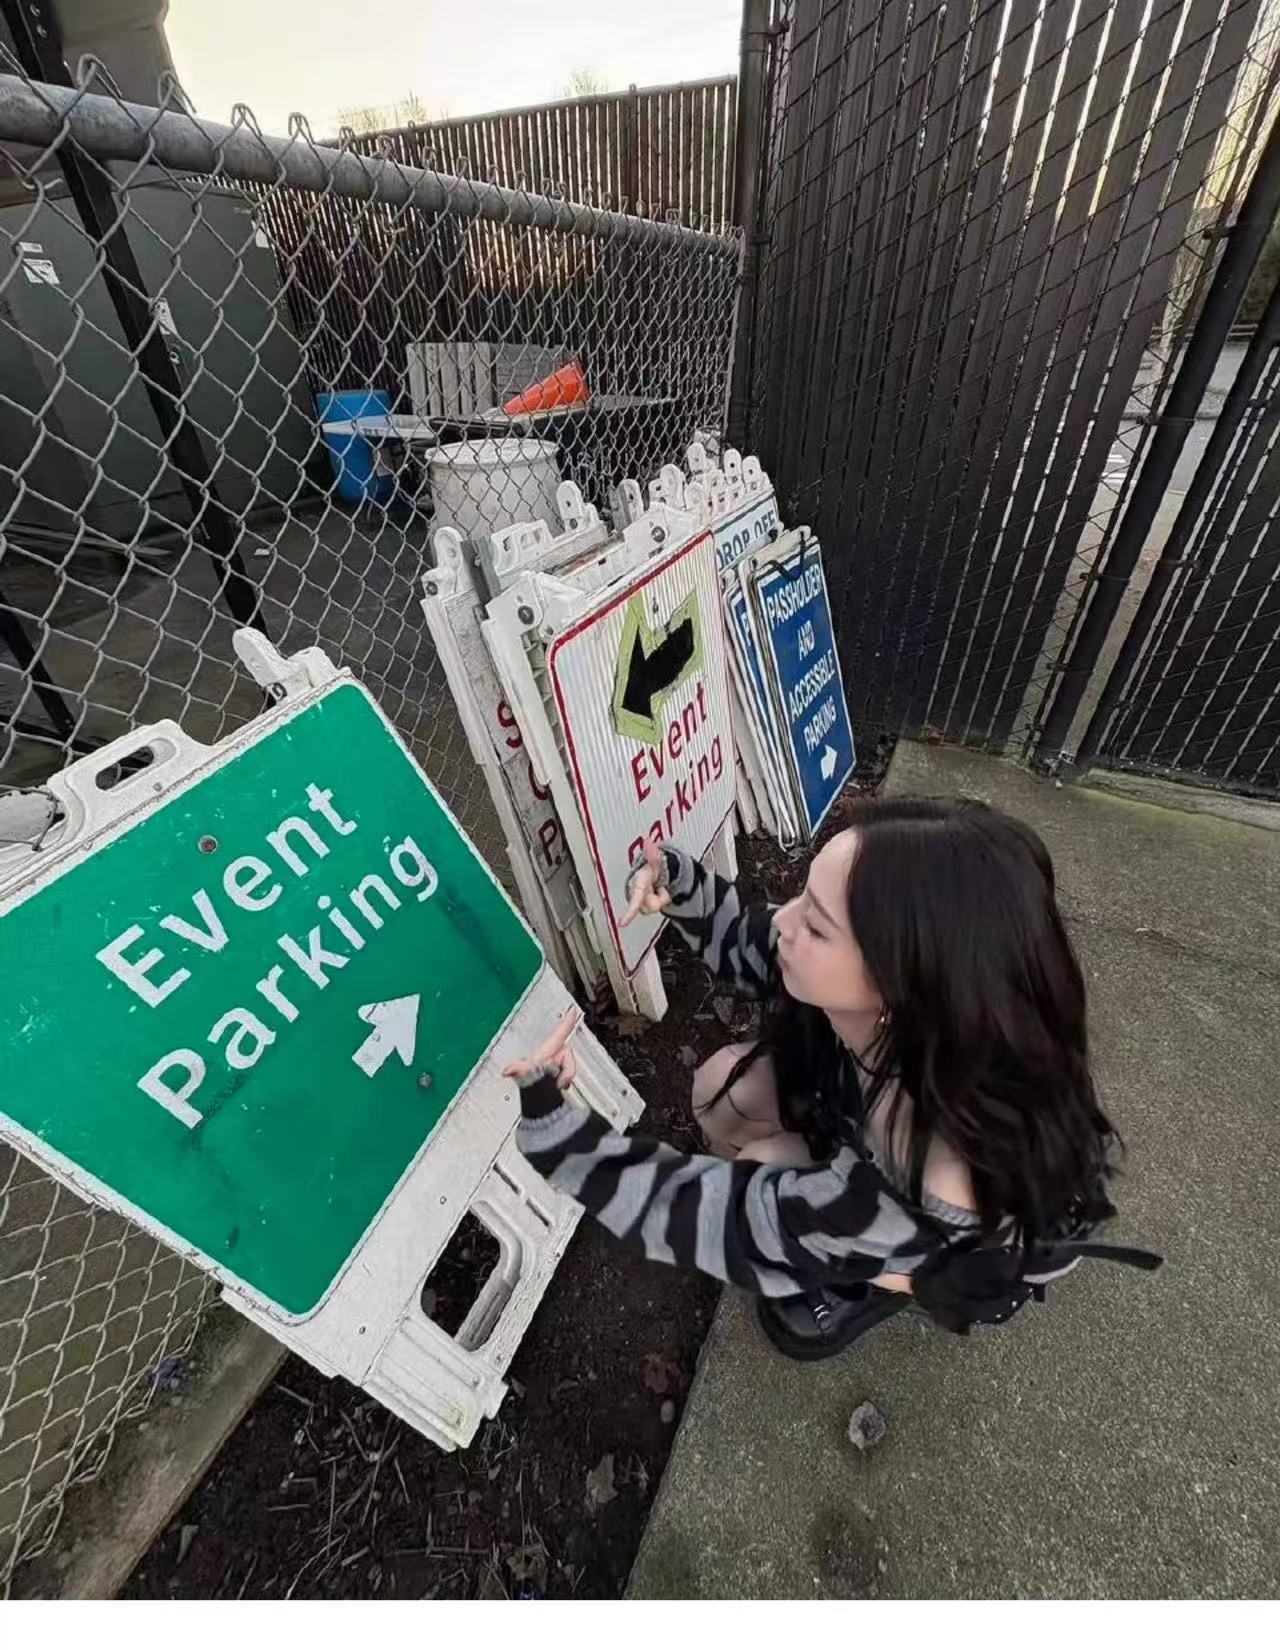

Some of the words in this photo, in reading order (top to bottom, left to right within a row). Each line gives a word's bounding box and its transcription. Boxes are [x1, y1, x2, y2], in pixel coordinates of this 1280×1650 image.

[766, 563, 823, 630] PASSHOLDER
[798, 620, 816, 661] AND
[789, 648, 836, 724] ACCESSIBLE
[631, 682, 708, 803] Event
[803, 695, 837, 756] PARKING
[95, 782, 358, 1009] Event
[137, 835, 439, 1130] Parking
